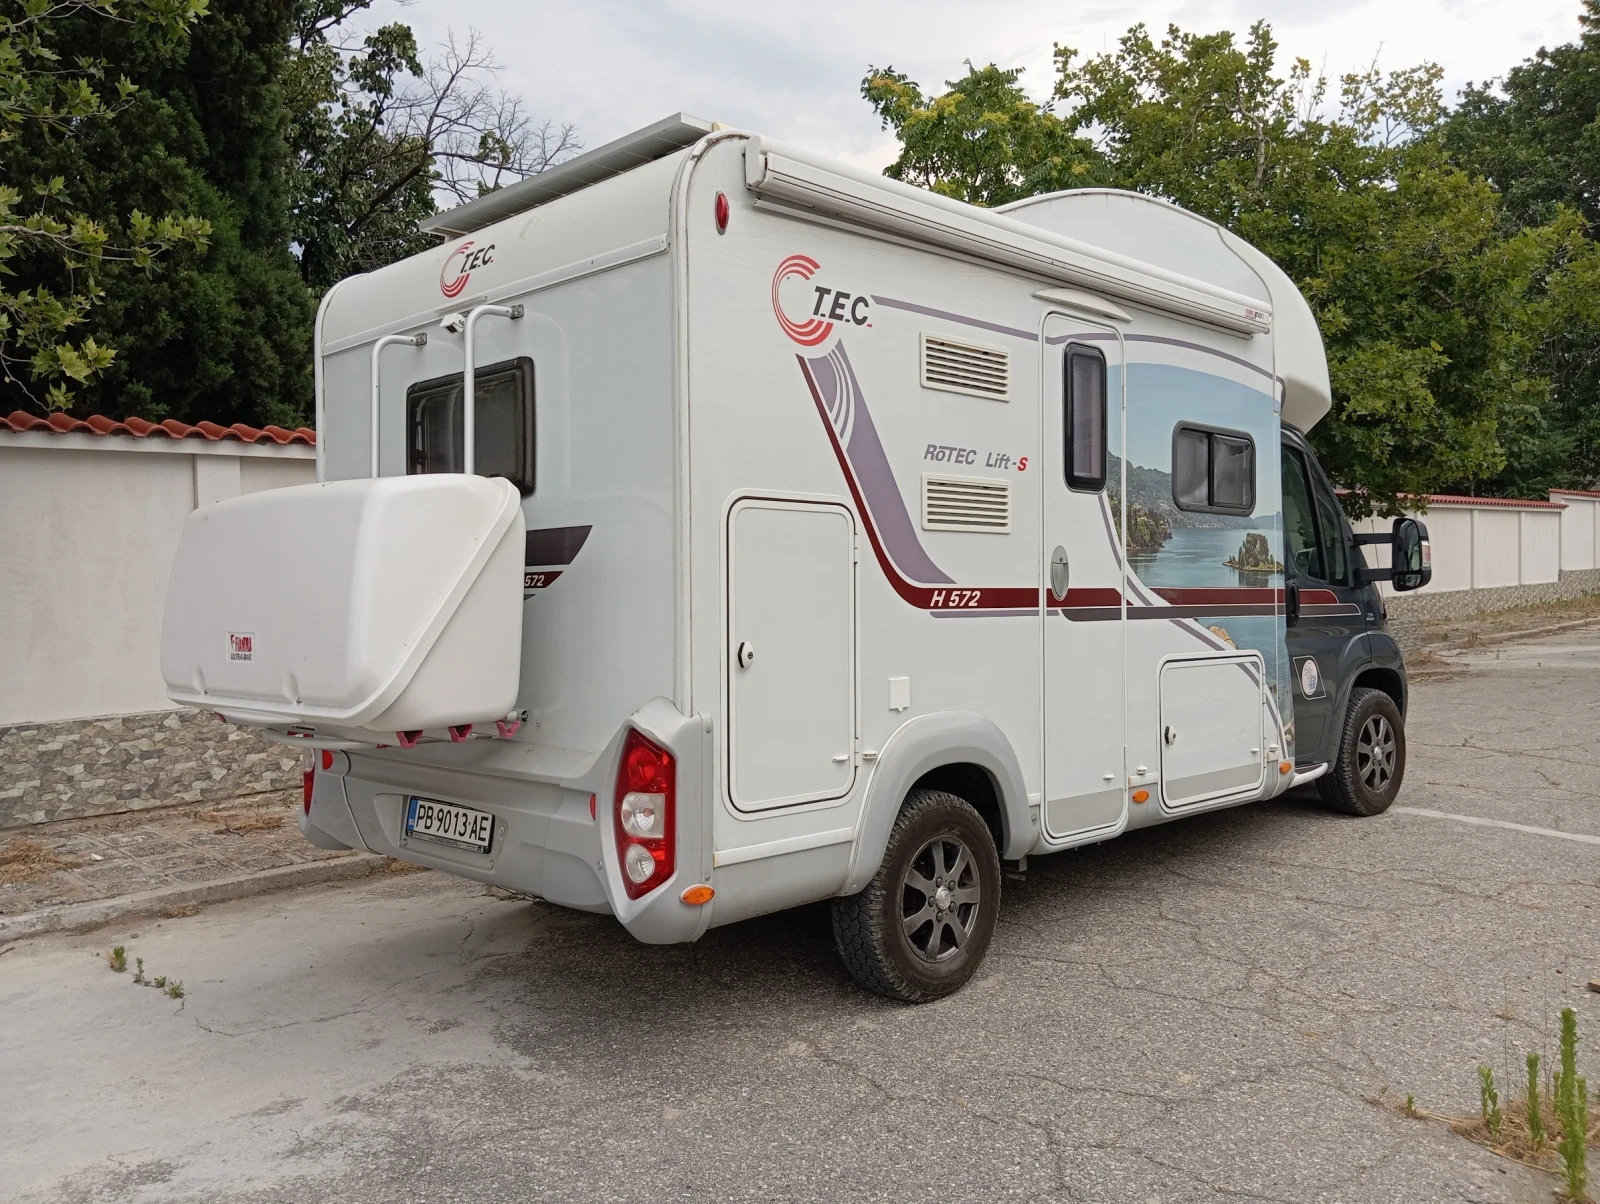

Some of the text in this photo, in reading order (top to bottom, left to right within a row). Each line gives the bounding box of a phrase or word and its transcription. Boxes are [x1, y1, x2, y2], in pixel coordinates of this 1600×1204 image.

[524, 574, 545, 587] 572
[929, 590, 981, 607] H 572
